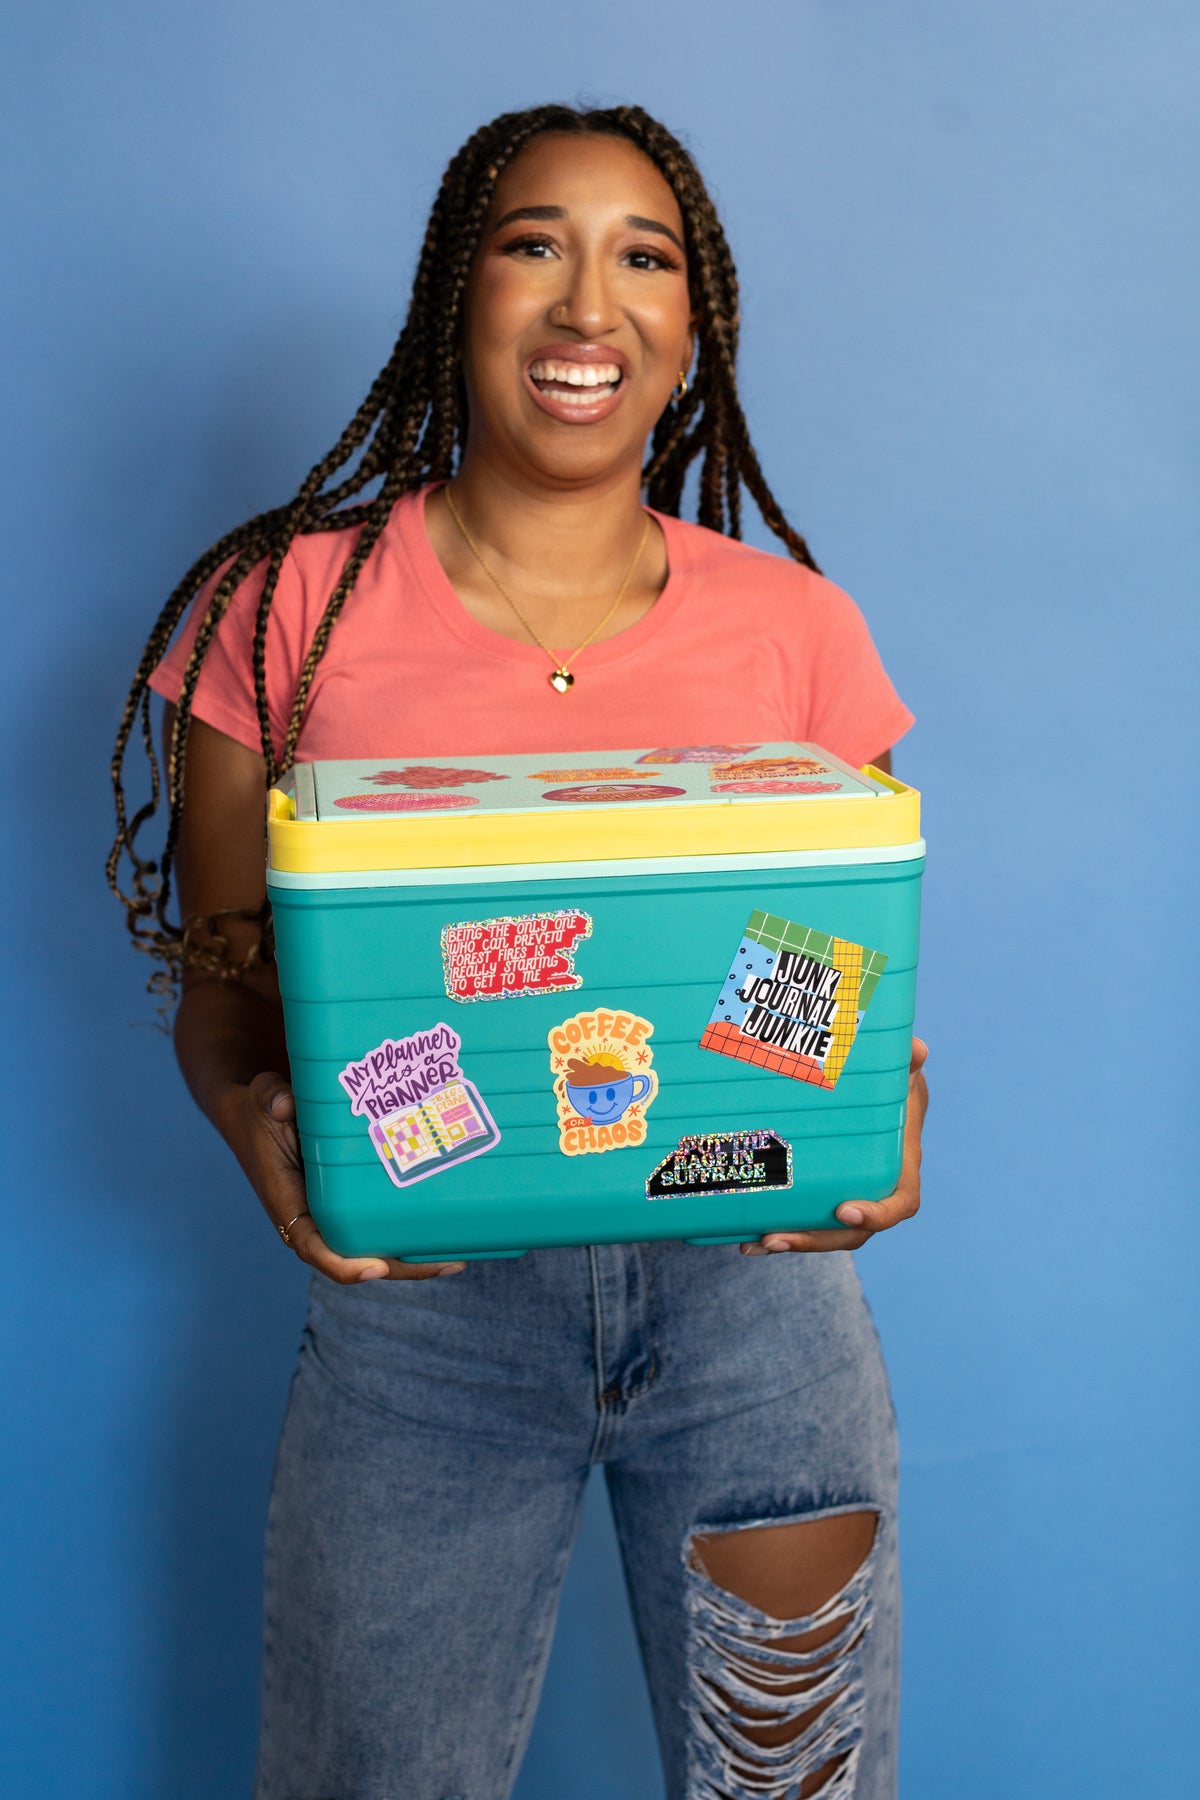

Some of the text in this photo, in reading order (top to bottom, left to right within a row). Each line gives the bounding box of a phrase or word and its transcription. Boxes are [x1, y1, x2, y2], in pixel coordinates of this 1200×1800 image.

[489, 923, 510, 938] THE
[516, 918, 548, 934] ONLY
[555, 916, 577, 930] ONE
[450, 940, 476, 955] WHO
[514, 929, 566, 948] PREVENT
[451, 944, 545, 967] FOREST FIRES IS
[452, 954, 559, 979] REALLY STARTING
[452, 978, 467, 991] TO
[473, 974, 496, 989] GET
[500, 972, 516, 986] TO
[522, 969, 541, 983] ME
[775, 951, 842, 1000] JUNK
[739, 977, 837, 1028] JOURNAL
[552, 1012, 650, 1055] COFFEE
[743, 1005, 833, 1058] JUNKIE
[356, 1052, 455, 1111] has a
[435, 1088, 458, 1101] BIG
[570, 1119, 585, 1127] OR
[564, 1119, 643, 1152] CHAOS
[681, 1133, 771, 1155] PUT THE
[673, 1149, 755, 1171] RAGE IN
[660, 1162, 766, 1186] SUFFRAGE
